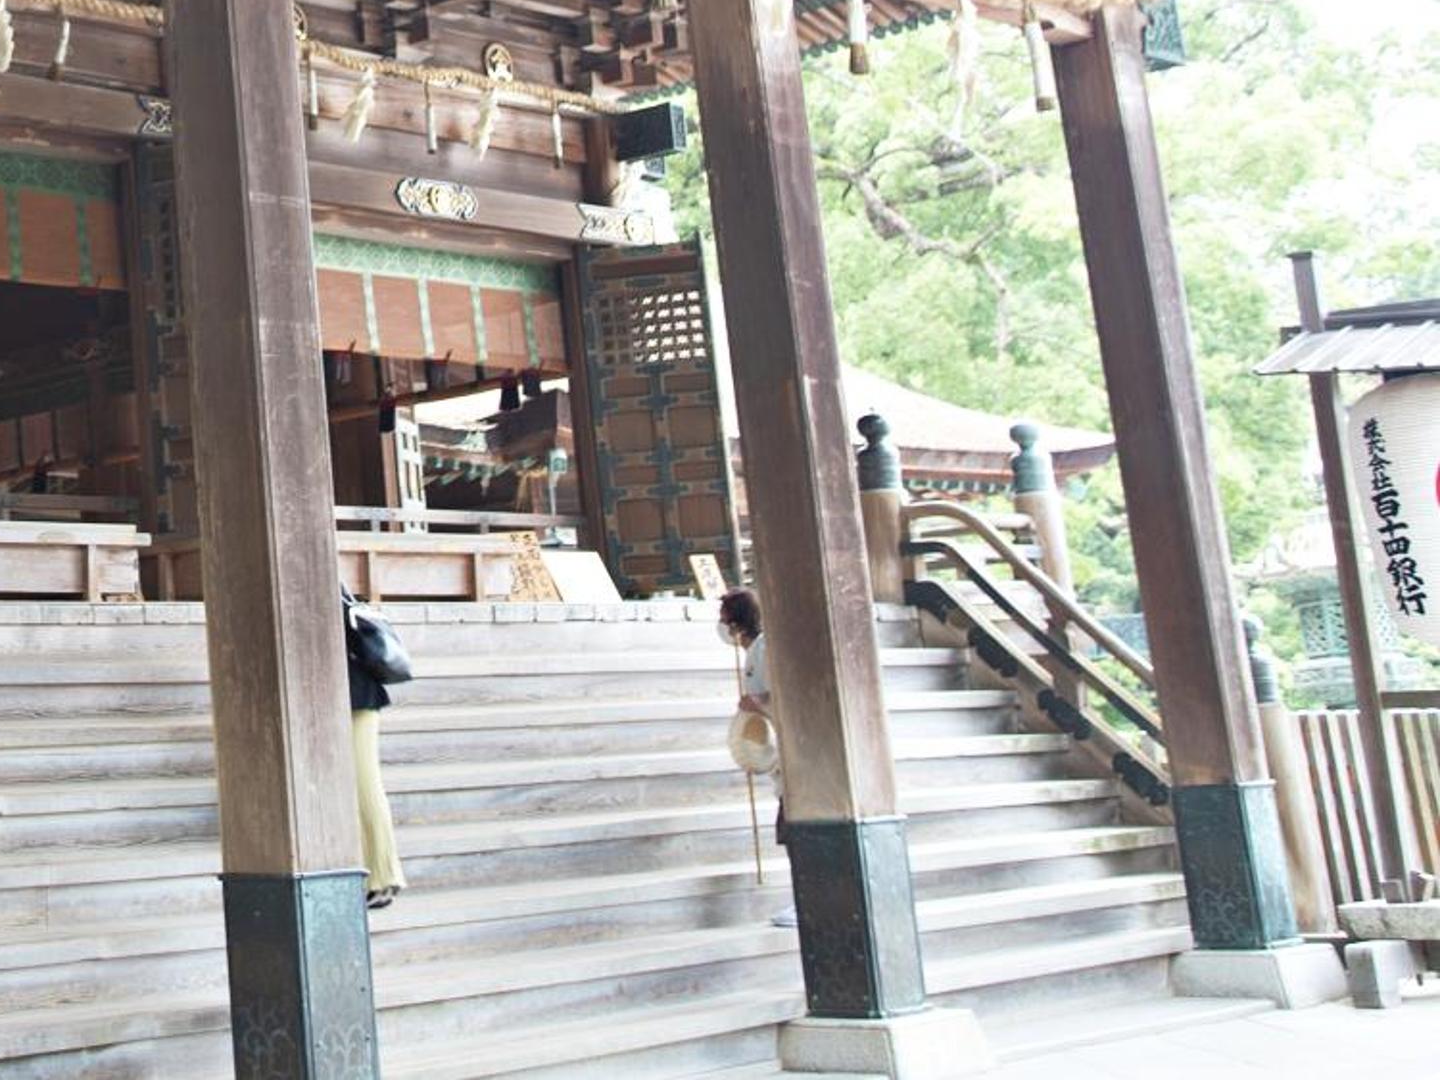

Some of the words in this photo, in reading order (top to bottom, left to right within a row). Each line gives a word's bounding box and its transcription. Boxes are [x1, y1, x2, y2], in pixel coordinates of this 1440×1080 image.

[1362, 416, 1427, 615] 株式会社百十四銀行
